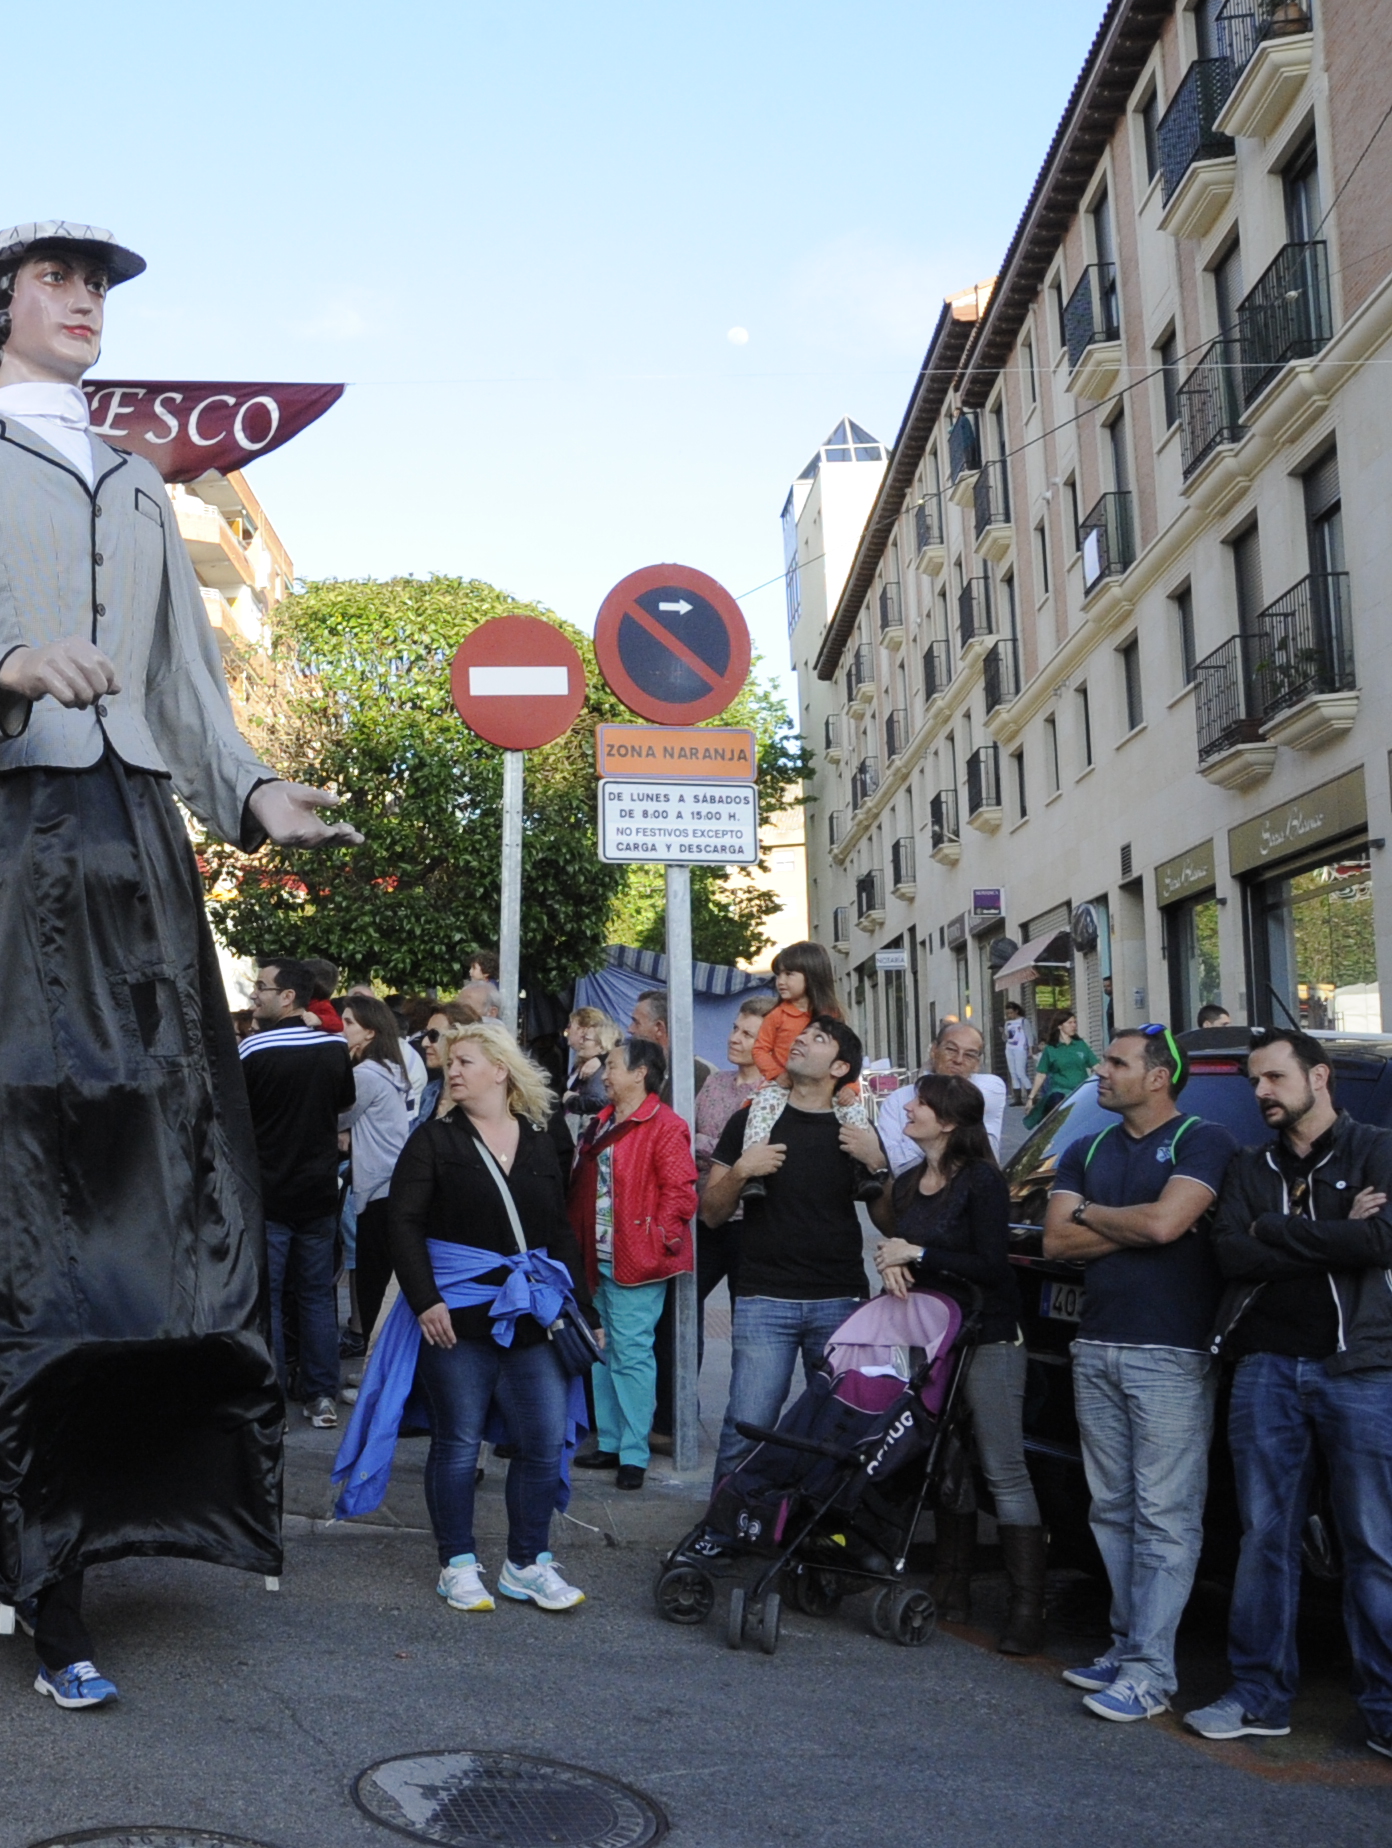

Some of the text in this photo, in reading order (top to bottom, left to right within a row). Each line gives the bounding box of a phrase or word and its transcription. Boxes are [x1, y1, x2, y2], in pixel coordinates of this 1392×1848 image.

[606, 744, 749, 762] ZONA NARANJA
[608, 792, 751, 805] DE LUNES A SÁBADOS
[619, 809, 741, 821] DE 8:00 A 15:00 H.
[616, 827, 744, 840] NO FESTIVOS EXCEPTO
[616, 842, 745, 854] CARGA Y DESCARGA
